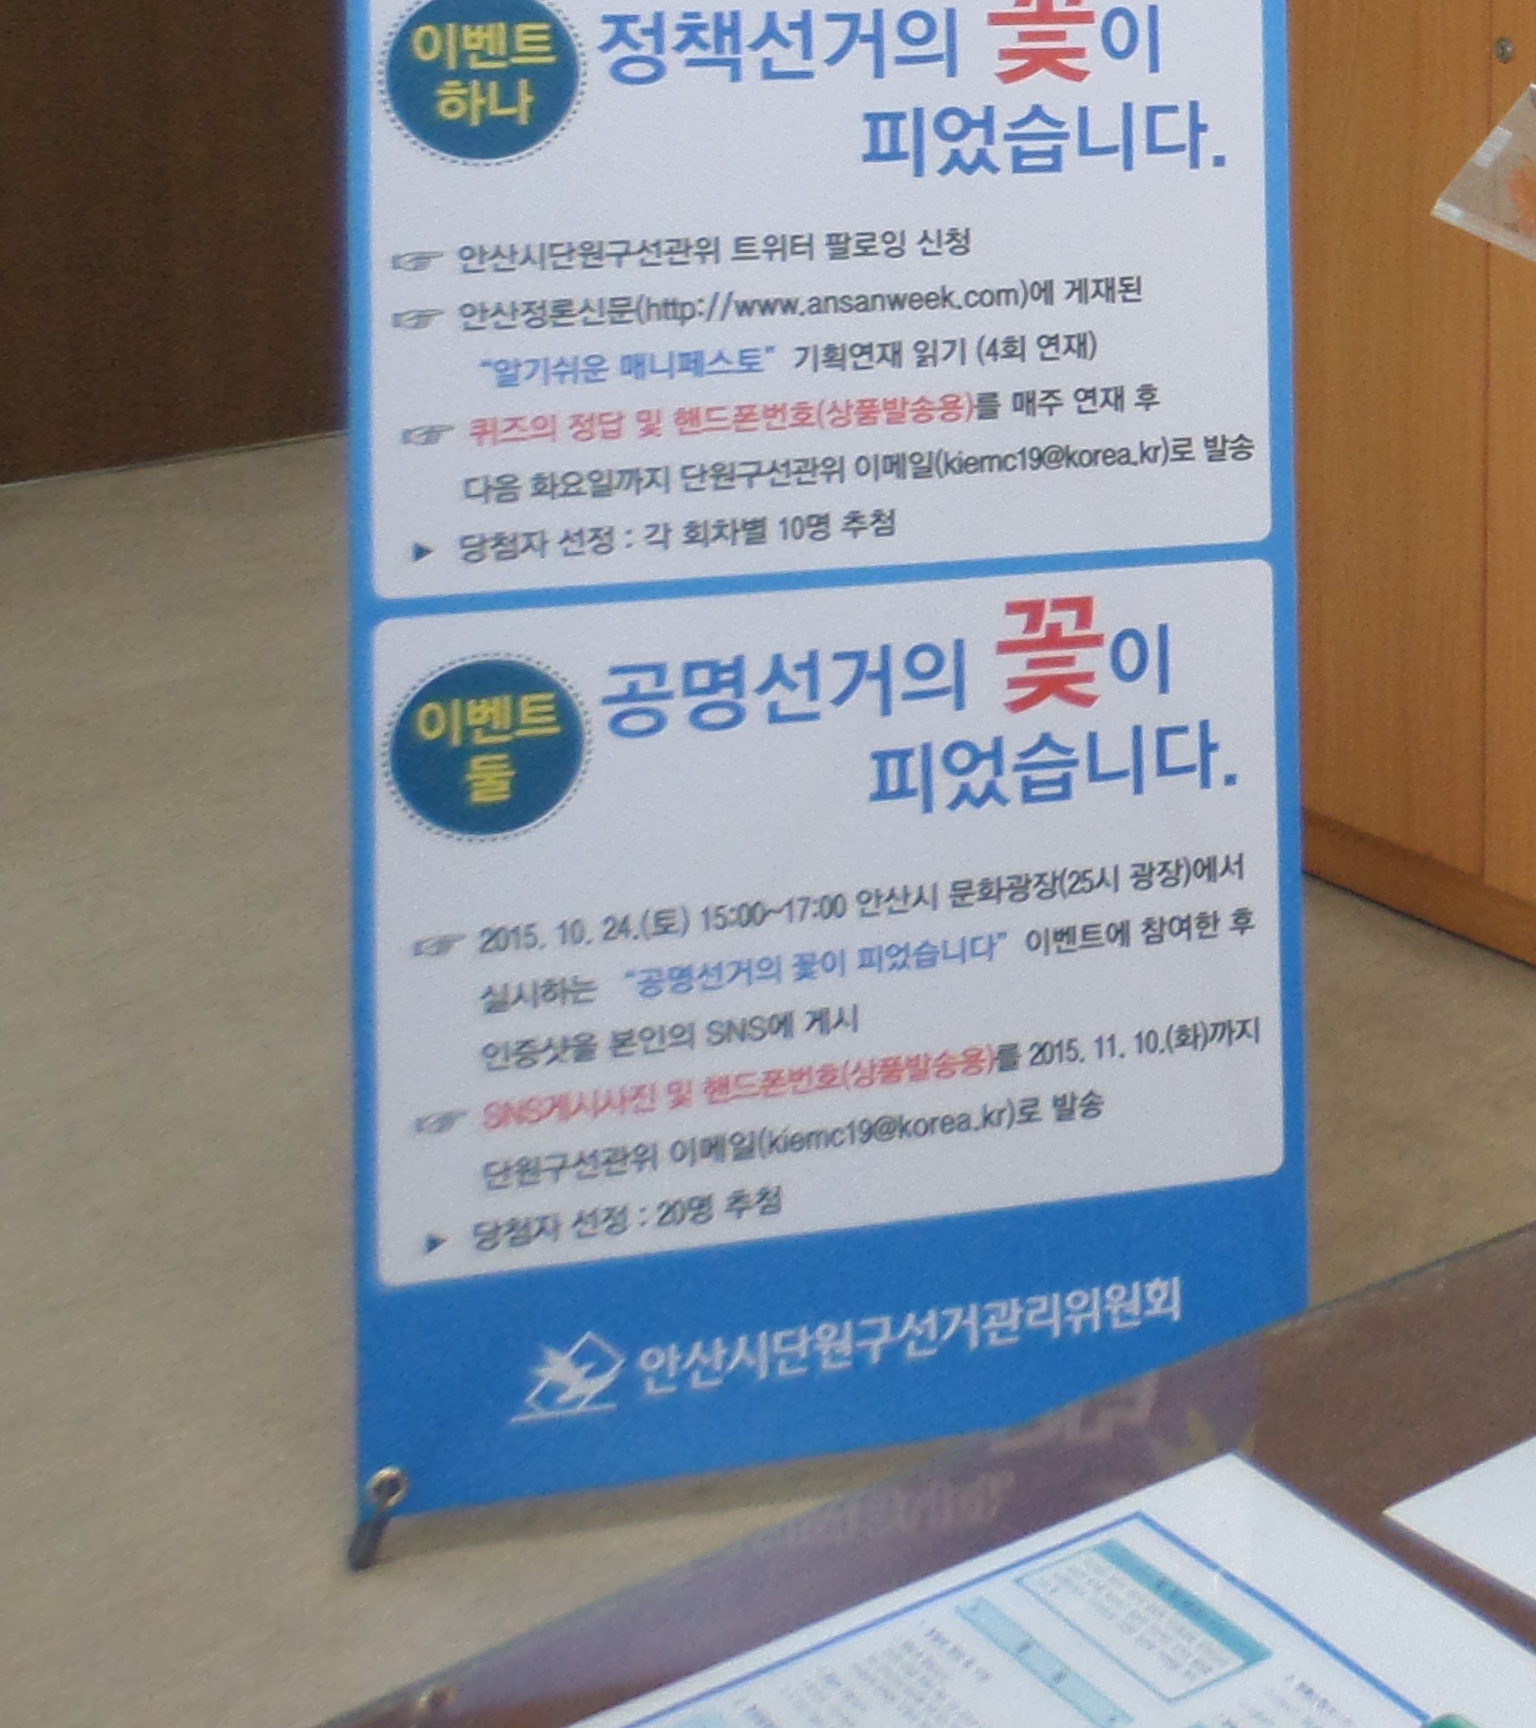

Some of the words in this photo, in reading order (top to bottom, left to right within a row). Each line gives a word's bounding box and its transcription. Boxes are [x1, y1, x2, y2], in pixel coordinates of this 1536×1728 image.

[411, 18, 558, 71] 이벤트
[599, 7, 960, 86] 정책선거의
[436, 78, 534, 127] 하나
[861, 99, 1228, 178] 피었습니다.
[457, 235, 721, 273] 안산시단원구선관위
[731, 232, 815, 263] 트위터
[825, 229, 907, 261] 팔로잉
[917, 227, 971, 258] 신청
[458, 278, 1054, 332] 안산정론신문(http://www.ansanweek.com)에
[1064, 275, 1143, 305] 게재된
[794, 341, 903, 372] 기획연재
[913, 337, 967, 368] 읽기
[977, 334, 1026, 365] (4회
[1036, 330, 1098, 361] 연재)
[468, 413, 558, 447] 퀴즈의
[568, 409, 625, 443] 정답
[636, 408, 662, 439] 및
[673, 392, 1000, 435] 핸드폰번호(상품발송용)를
[1012, 390, 1064, 418] 매주
[1074, 384, 1125, 414] 연재
[1134, 383, 1160, 412] 후
[463, 473, 520, 504] 다음
[529, 465, 671, 501] 화요일까지
[680, 455, 845, 494] 단원구선관위
[1203, 433, 1256, 462] 발송
[458, 529, 549, 564] 당첨자
[558, 524, 615, 558] 선정
[643, 522, 672, 550] 각
[682, 516, 768, 548] 회차별
[777, 512, 832, 543] 10명
[840, 507, 897, 539] 추첨
[601, 636, 968, 740] 공명선거의
[996, 594, 1172, 714] 꽃이
[416, 690, 562, 746] 이벤트
[463, 753, 516, 803] 둘
[867, 719, 1239, 815] 피었습니다.
[478, 925, 546, 954] 2015.
[556, 918, 593, 946] 10.
[601, 904, 690, 943] 24.(토)
[700, 892, 848, 932] 15:00~17:00
[856, 882, 939, 918] 안산시
[949, 865, 1120, 909] 문화광장(25시
[1129, 852, 1245, 892] 광장)에서
[479, 975, 598, 1015] 실시하는
[792, 947, 847, 983] 꽃이
[1025, 918, 1130, 956] 이벤트에
[1140, 911, 1220, 946] 참여한
[1229, 906, 1256, 935] 후
[608, 1021, 696, 1059] 본인의
[705, 1011, 795, 1048] SNS에
[804, 1004, 860, 1034] 게시
[482, 1080, 658, 1131] SNS게시사진
[667, 1078, 694, 1111] 및
[1028, 1038, 1086, 1067] 2015.
[1094, 1033, 1125, 1059] 11.
[1134, 1016, 1261, 1055] 10.(화)까지
[482, 1141, 659, 1192] 단원구선관위
[1052, 1089, 1105, 1123] 발송
[473, 1210, 561, 1252] 당첨자
[571, 1202, 630, 1239] 선정
[655, 1193, 714, 1227] 20명
[724, 1185, 783, 1220] 추첨
[637, 1273, 1183, 1397] 안산시단원구선거관리위원회
